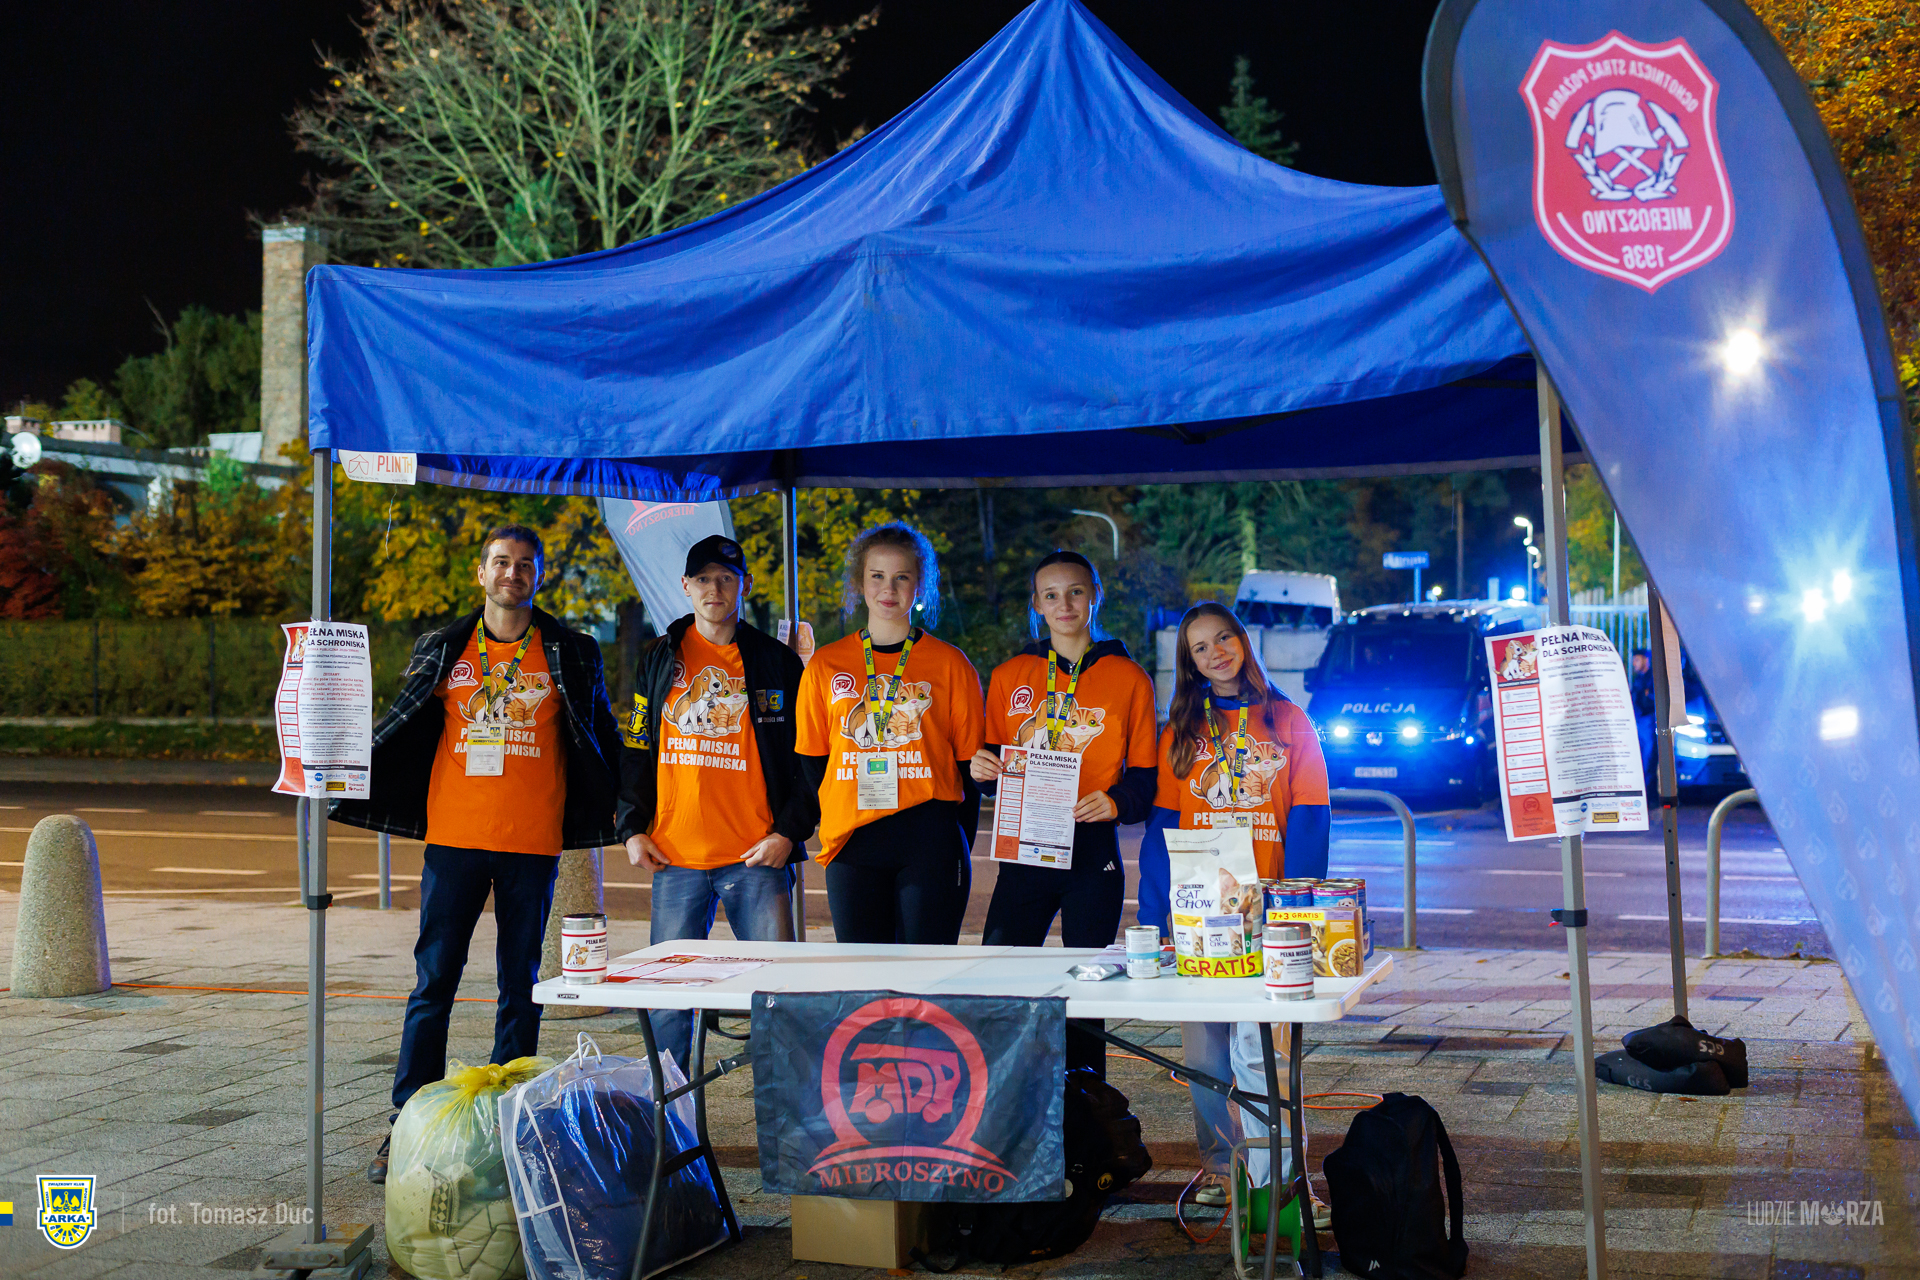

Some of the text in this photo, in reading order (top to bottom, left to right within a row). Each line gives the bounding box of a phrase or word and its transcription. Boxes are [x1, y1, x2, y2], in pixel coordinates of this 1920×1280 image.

[377, 455, 413, 474] PLINTH
[336, 629, 365, 639] MISKA
[1541, 632, 1609, 646] PEŁNA MISKA
[317, 640, 365, 649] SCHRONISKA
[1542, 644, 1614, 658] DLA SCHRONISKA
[1341, 703, 1416, 714] POLICJA
[505, 744, 541, 758] ONISKA
[667, 737, 740, 756] PEŁNA MISKA
[660, 752, 747, 771] DLA SCHRONISKA
[898, 751, 922, 764] SKA
[1030, 753, 1053, 761] PEŁNA
[836, 768, 854, 780] DLA
[1253, 812, 1276, 826] SKA
[1176, 889, 1201, 899] CAT
[1175, 898, 1215, 909] CHOW
[819, 1161, 1005, 1193] MIEROSZYNO
